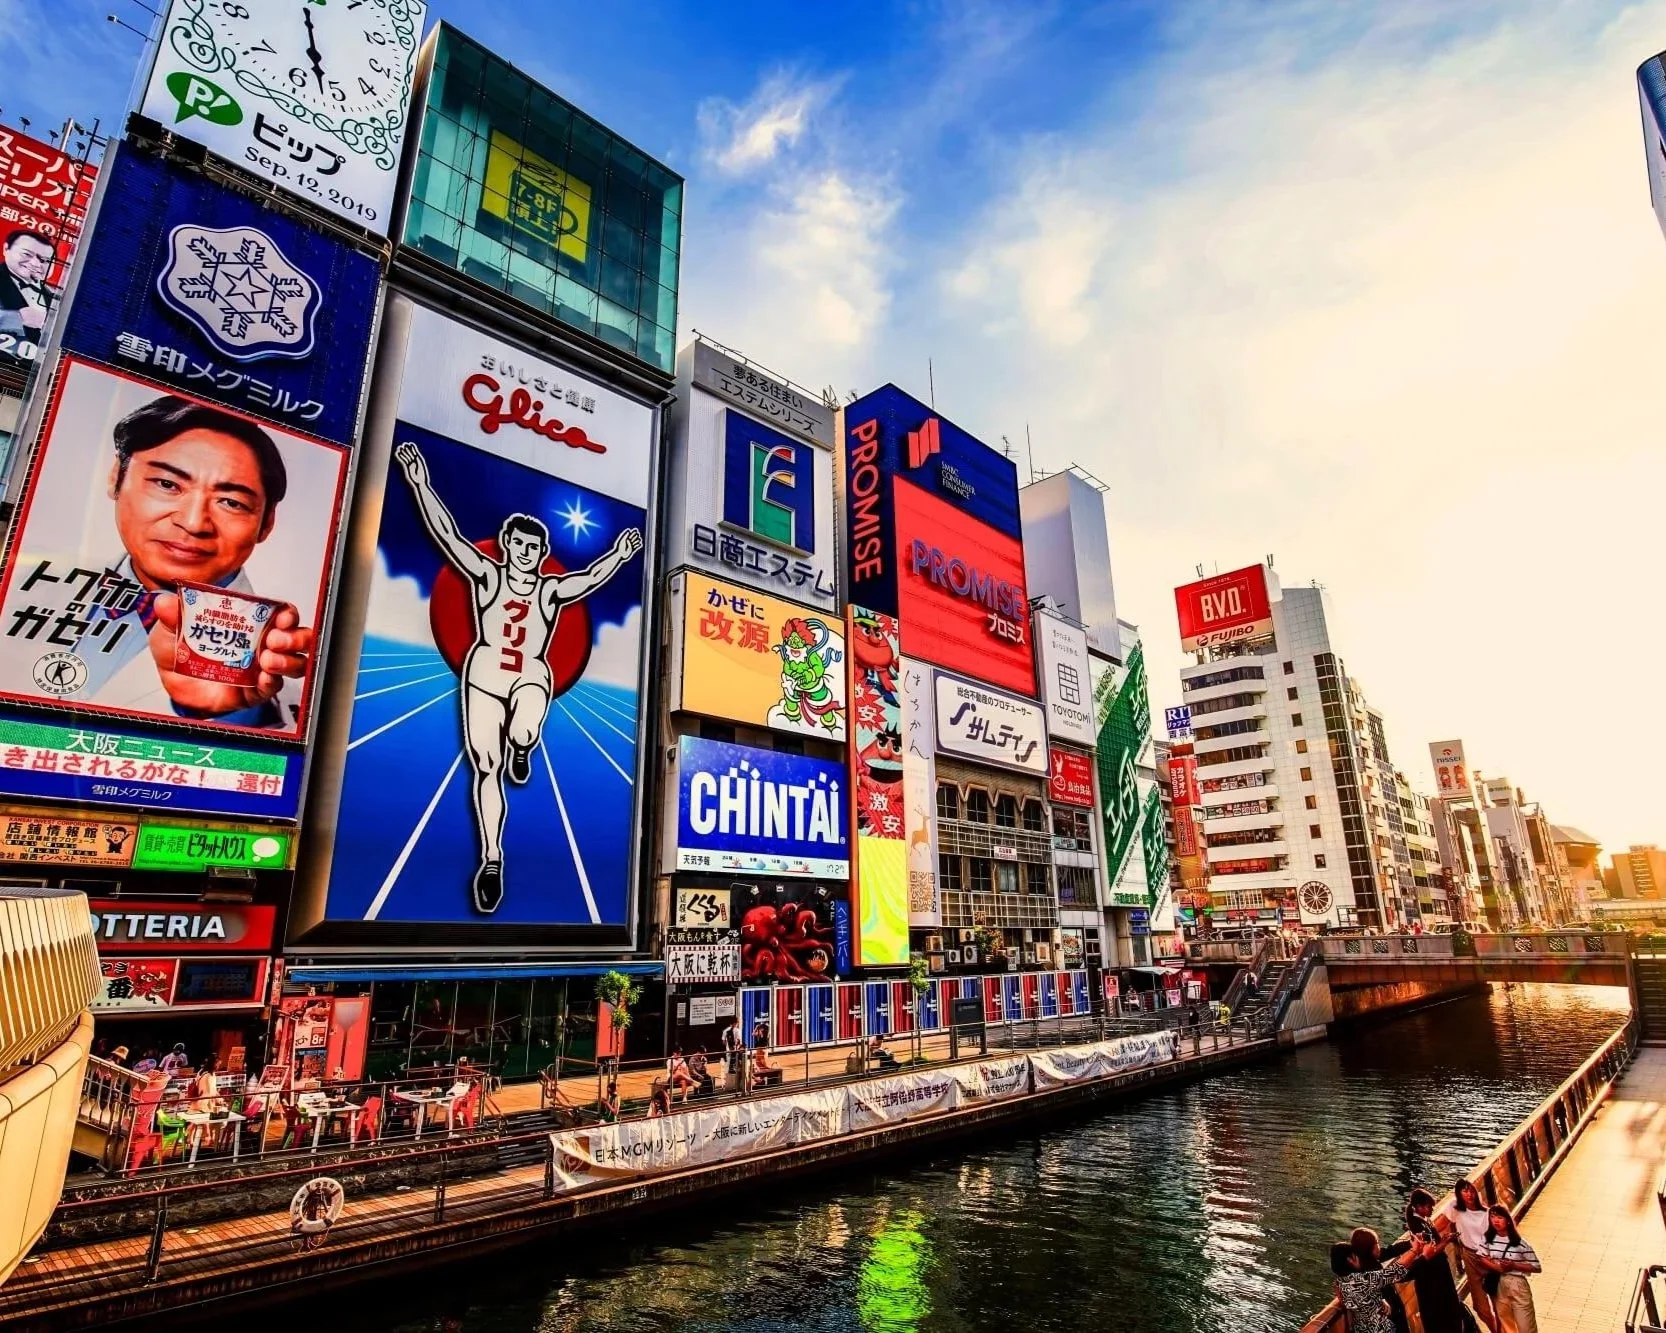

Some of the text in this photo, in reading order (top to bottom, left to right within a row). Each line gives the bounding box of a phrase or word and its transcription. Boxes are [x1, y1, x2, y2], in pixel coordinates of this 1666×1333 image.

[222, 2, 249, 20] 8
[288, 67, 307, 88] 6
[328, 80, 346, 101] 5
[358, 77, 377, 96] 4
[252, 112, 346, 175] ピップ
[245, 147, 377, 221] Sep. 12, 2019
[115, 331, 324, 420] 雪印メグミルク
[480, 353, 597, 414] おいしさと健康
[732, 364, 803, 409] 夢ある住まい
[462, 373, 607, 454] Glico
[720, 378, 815, 434] エステムシリーズ
[851, 418, 882, 583] PROMISE
[693, 523, 835, 597] 日商エステム
[19, 560, 143, 612] トクホ
[911, 538, 1024, 622] PROMISE
[66, 602, 83, 615] の
[707, 588, 765, 621] かぜに
[1200, 587, 1247, 623] B.V.D.
[7, 605, 130, 654] ガセリ
[500, 600, 532, 674] グリコ
[699, 608, 771, 654] 改源
[987, 613, 1026, 646] プロミス
[1210, 625, 1254, 643] FUJIBO
[198, 643, 238, 658] ヨーグルト
[65, 730, 216, 766] 大阪ニュース
[966, 716, 1024, 751] サムティ
[91, 784, 173, 801] 雪印メグミルク
[236, 772, 281, 795] 還付
[869, 791, 901, 833] 激安
[7, 822, 98, 839] 店舗情報館
[187, 832, 246, 861] ピタットハウス
[683, 854, 711, 866] 天気予報
[686, 893, 720, 922] くくる
[671, 951, 731, 976] 大阪に乾杯
[312, 1034, 325, 1045] 8F
